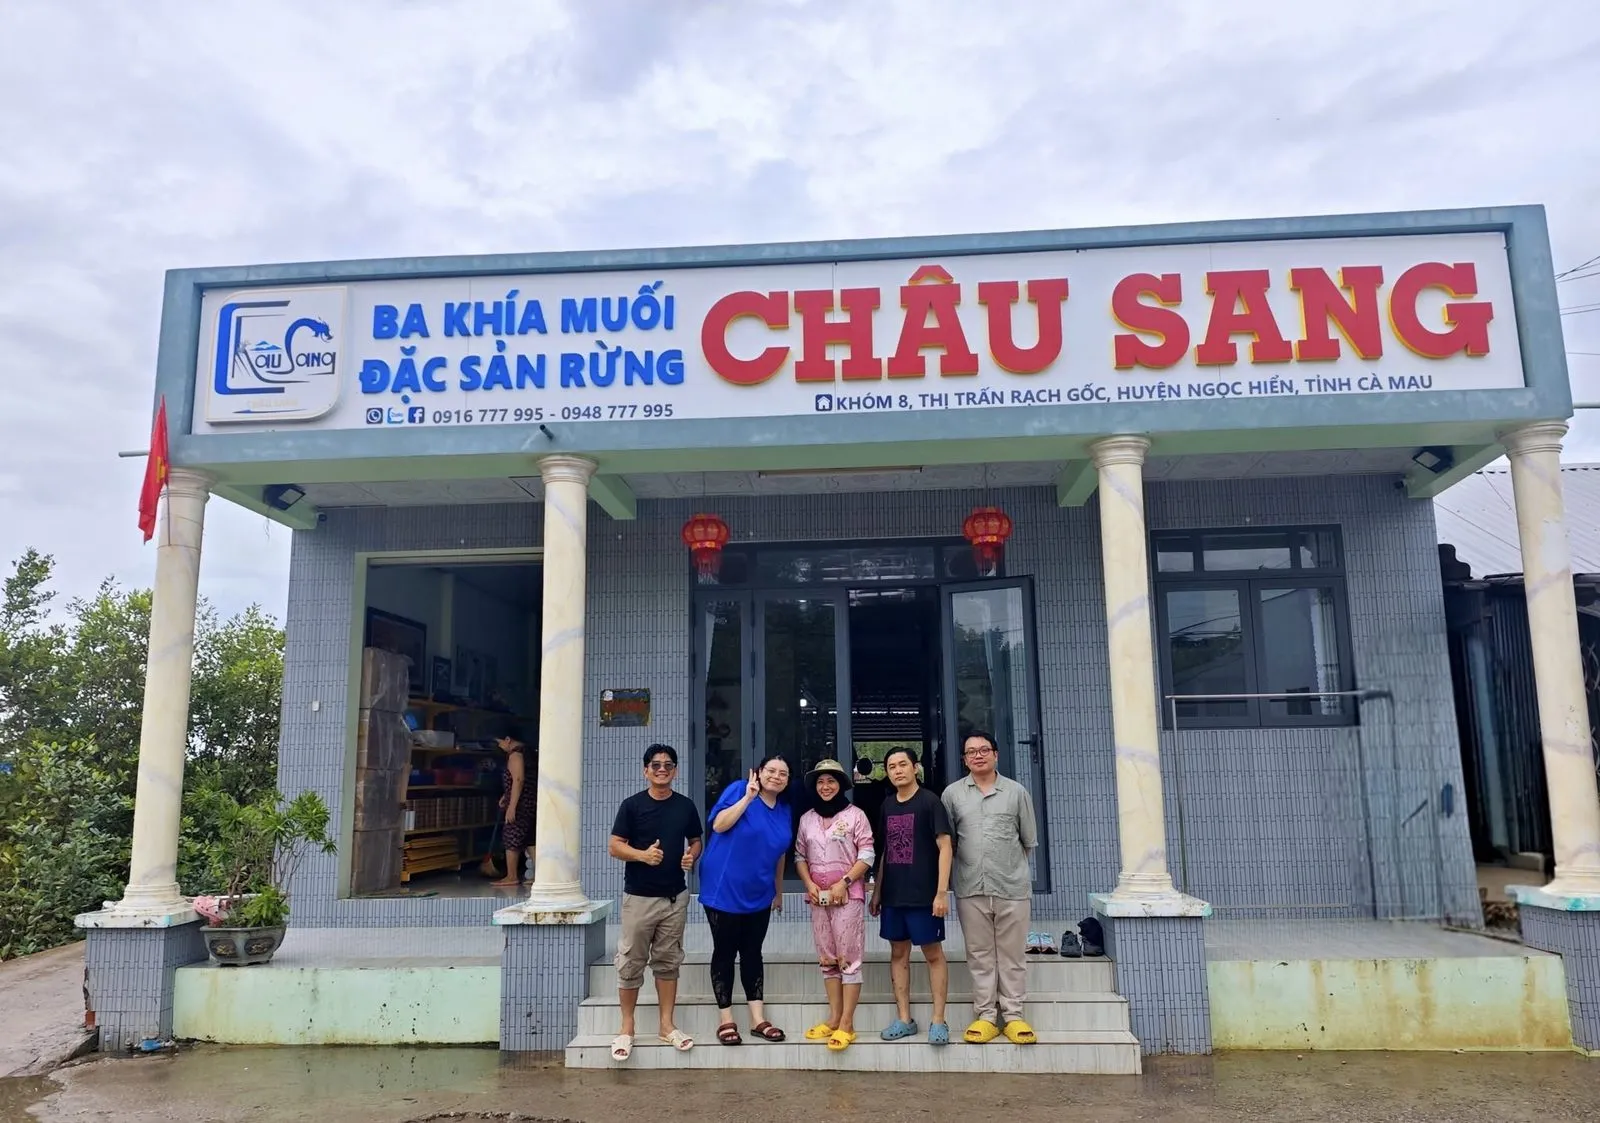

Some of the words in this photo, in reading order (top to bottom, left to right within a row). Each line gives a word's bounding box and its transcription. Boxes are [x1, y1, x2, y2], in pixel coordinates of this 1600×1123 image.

[373, 303, 430, 340] BA
[444, 290, 548, 338] KHÍA
[561, 280, 675, 334] MUỐI
[701, 265, 1069, 385] CHÂU
[1111, 261, 1494, 369] SANG
[359, 345, 448, 404] ĐẶC
[460, 340, 546, 392] SẢN
[560, 340, 685, 388] RỪNG
[837, 392, 893, 411] KHÓM
[898, 394, 913, 410] 8,
[918, 393, 949, 410] THỊ
[954, 386, 1004, 406] TRẤN
[1011, 389, 1061, 406] RẠCH
[1067, 383, 1111, 403] GỐC,
[1117, 381, 1181, 401] HUYỆN
[1188, 382, 1243, 399] NGỌC
[1248, 375, 1299, 396] HIỂN,
[1304, 374, 1352, 393] TỈNH
[1357, 372, 1384, 391] CÀ
[1388, 375, 1433, 390] MAU
[432, 410, 473, 424] 0916
[479, 408, 508, 422] 777
[513, 407, 544, 421] 995
[561, 406, 602, 420] 0948
[607, 404, 638, 419] 777
[643, 403, 674, 418] 995
